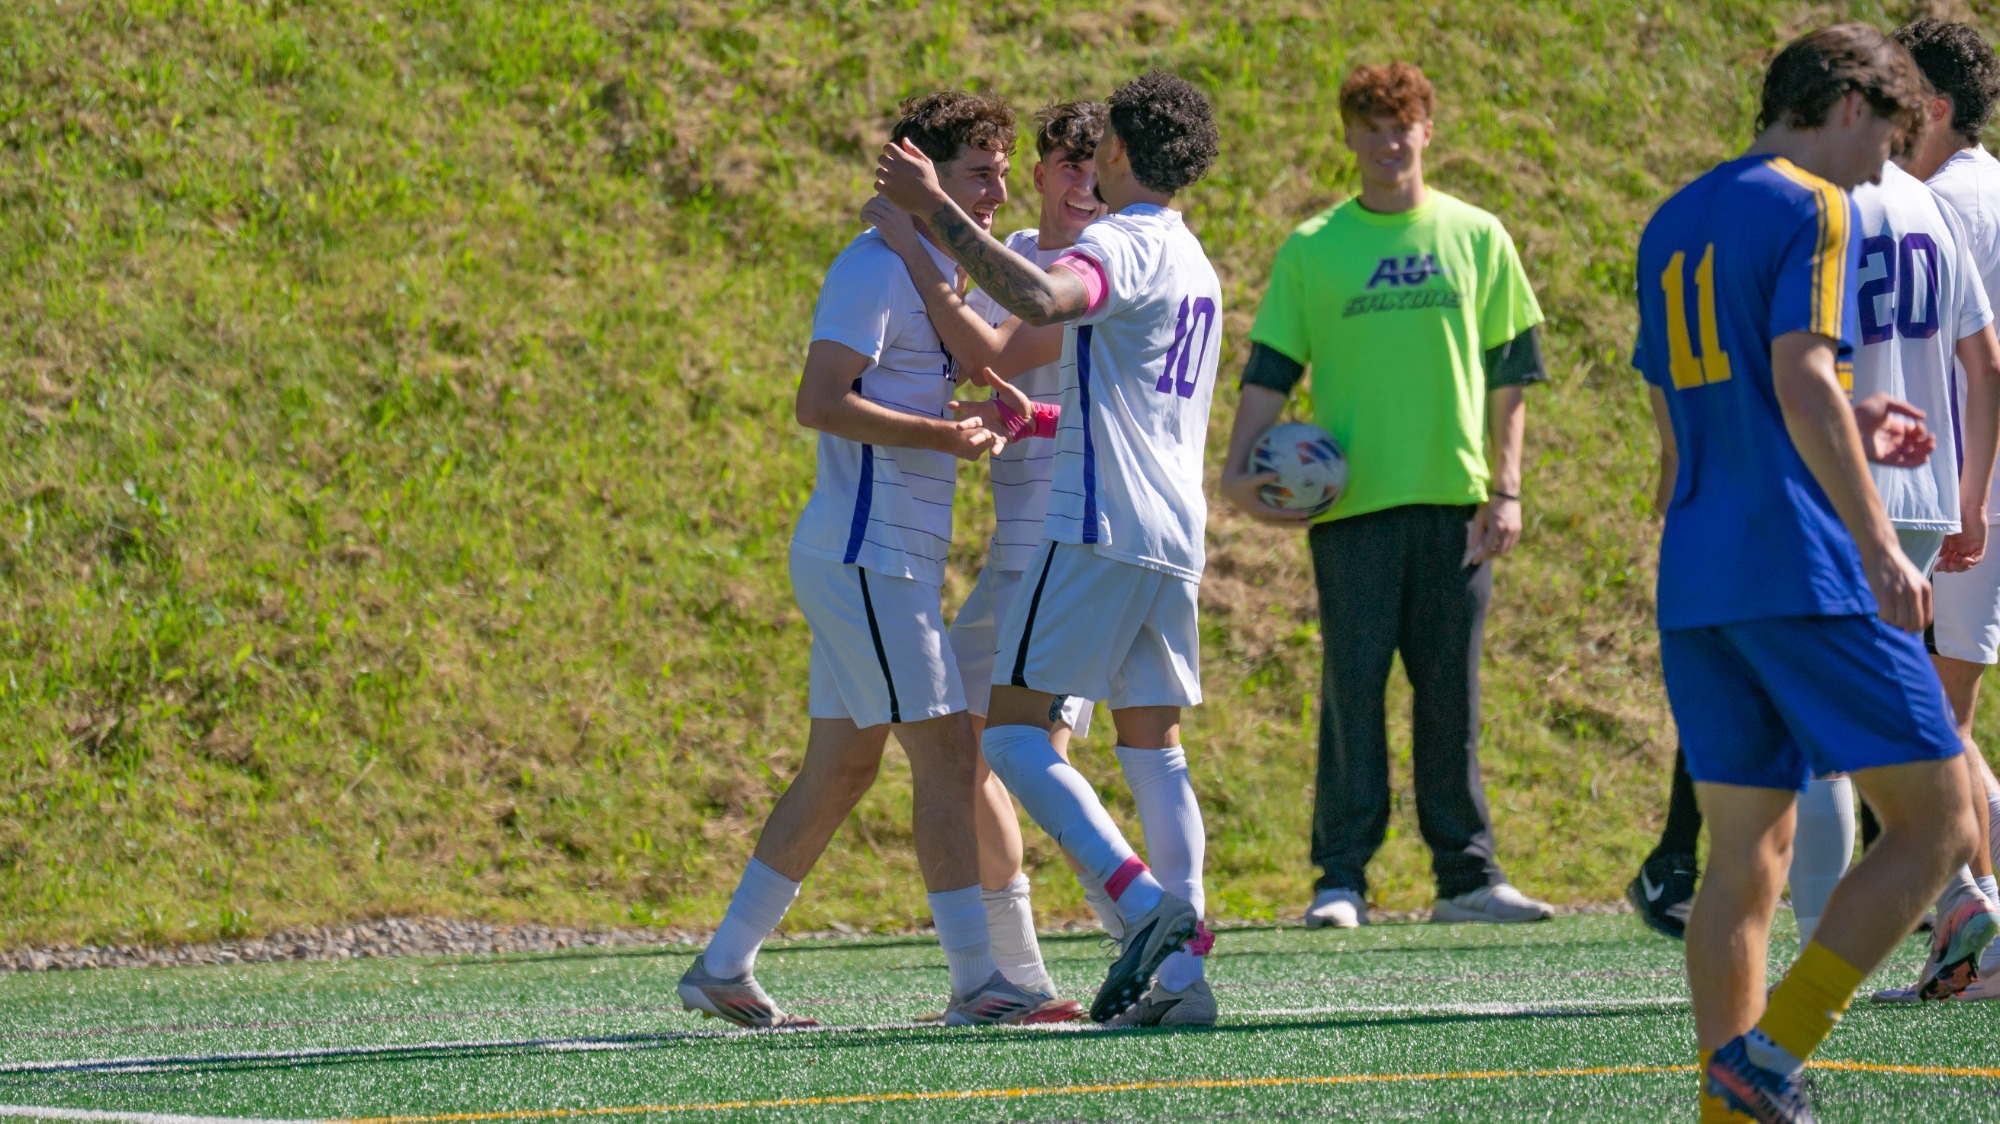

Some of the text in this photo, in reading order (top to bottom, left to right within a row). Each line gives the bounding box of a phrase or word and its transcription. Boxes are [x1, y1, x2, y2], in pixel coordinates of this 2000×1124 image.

[1364, 254, 1439, 291] AU
[1661, 241, 1732, 390] 11
[1857, 232, 1940, 346] 20
[1155, 294, 1215, 400] 10
